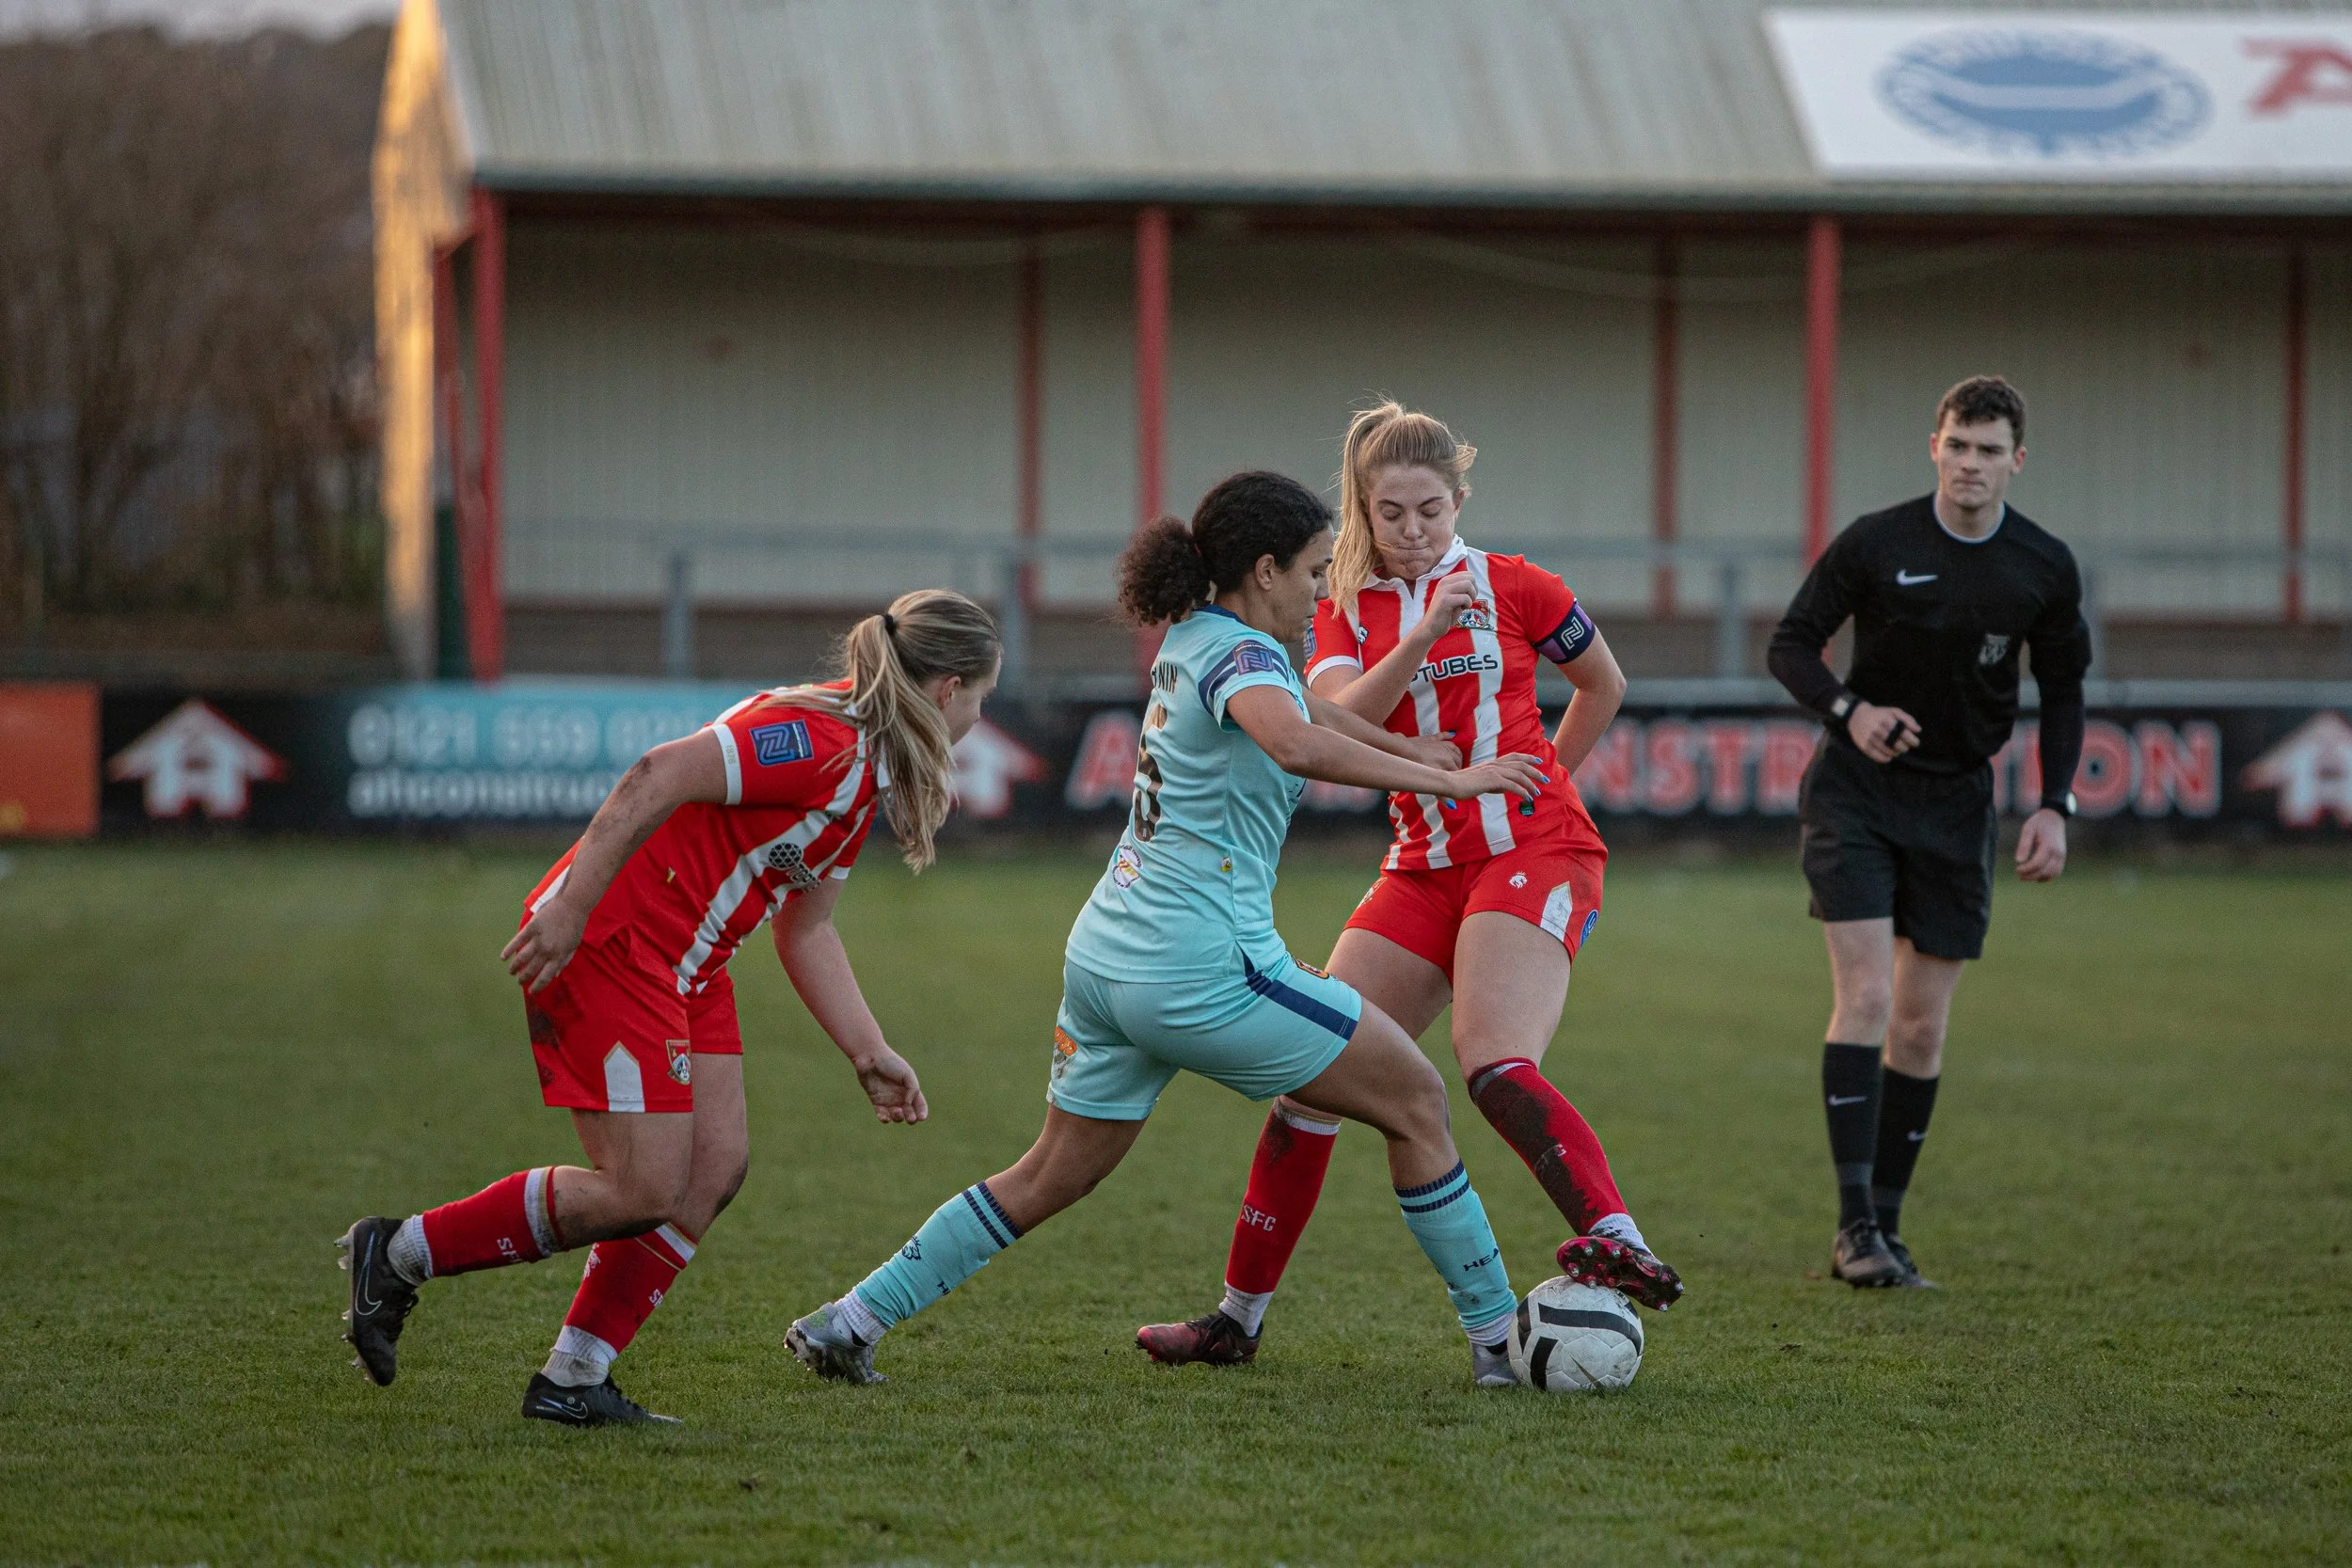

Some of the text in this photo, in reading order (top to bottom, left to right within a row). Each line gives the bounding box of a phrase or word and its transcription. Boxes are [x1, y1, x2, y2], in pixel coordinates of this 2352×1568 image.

[1411, 655, 1499, 683] TUBES
[347, 704, 476, 768] 0121
[1242, 1204, 1277, 1231] SFC
[497, 1237, 522, 1262] SF
